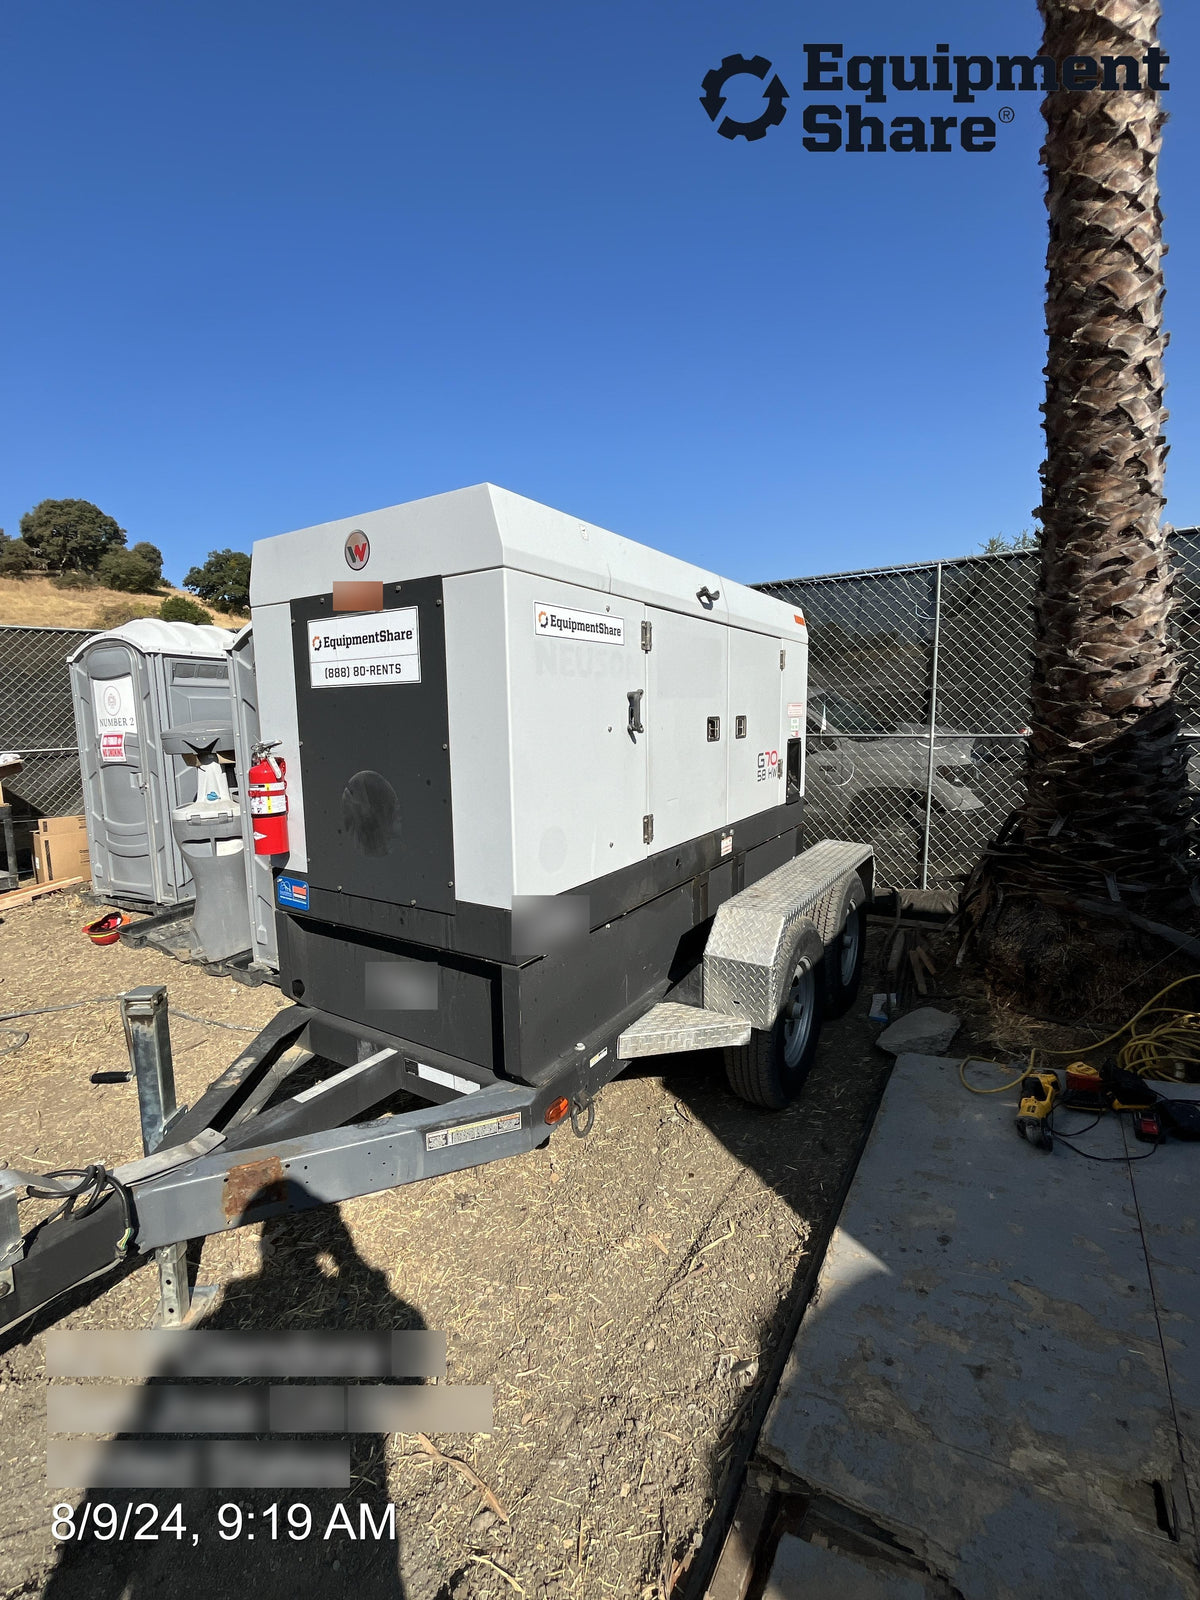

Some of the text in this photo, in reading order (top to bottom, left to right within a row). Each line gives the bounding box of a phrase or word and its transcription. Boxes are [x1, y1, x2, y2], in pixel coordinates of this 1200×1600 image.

[550, 614, 622, 637] EquipmentShare
[323, 629, 413, 650] EquipmentShare
[324, 663, 402, 679] (888) 80-RENTS
[99, 717, 134, 727] NUMBER 2
[757, 750, 778, 769] G70
